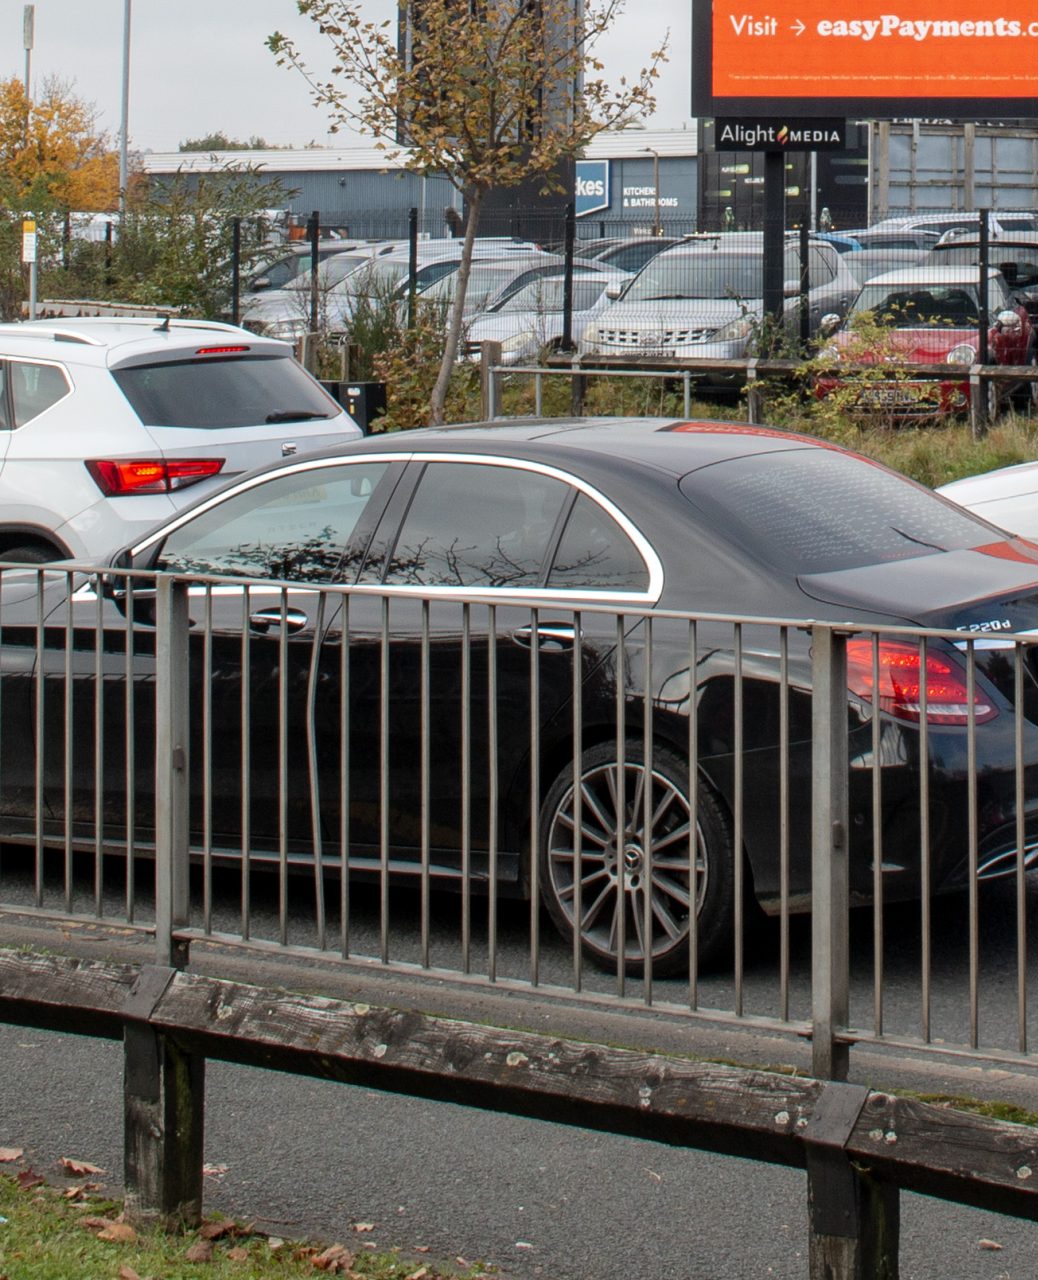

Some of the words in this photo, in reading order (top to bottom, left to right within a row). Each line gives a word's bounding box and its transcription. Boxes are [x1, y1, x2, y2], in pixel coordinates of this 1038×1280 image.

[729, 15, 779, 37] Visit
[720, 124, 775, 146] Alight
[790, 130, 840, 142] MEDIA
[575, 177, 604, 197] kes
[623, 198, 630, 207] &
[631, 198, 678, 207] BATHROMS
